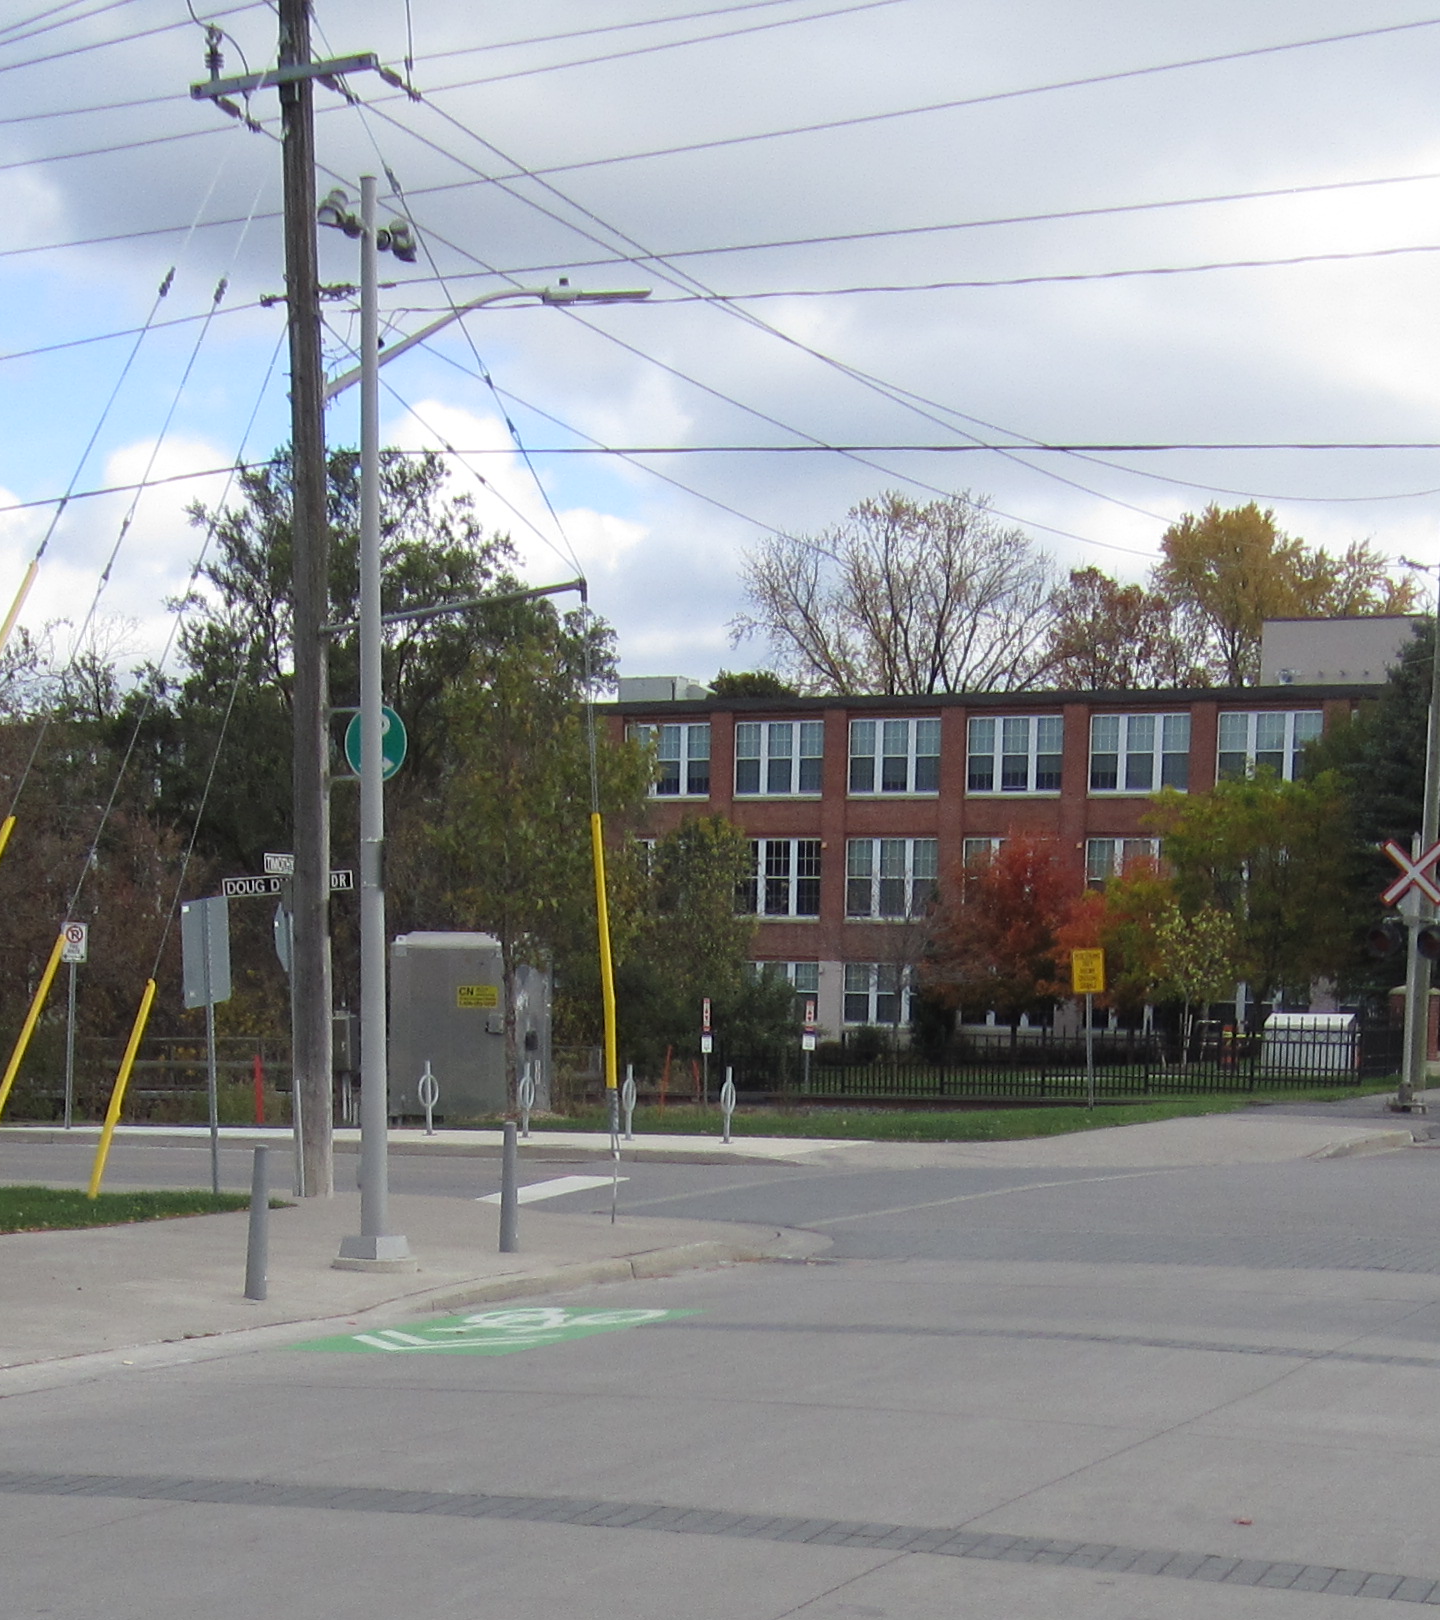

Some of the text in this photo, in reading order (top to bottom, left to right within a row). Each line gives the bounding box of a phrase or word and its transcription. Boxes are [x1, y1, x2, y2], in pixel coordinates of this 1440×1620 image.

[226, 879, 265, 895] DOUG
[331, 874, 347, 888] DR
[459, 987, 474, 996] CN
